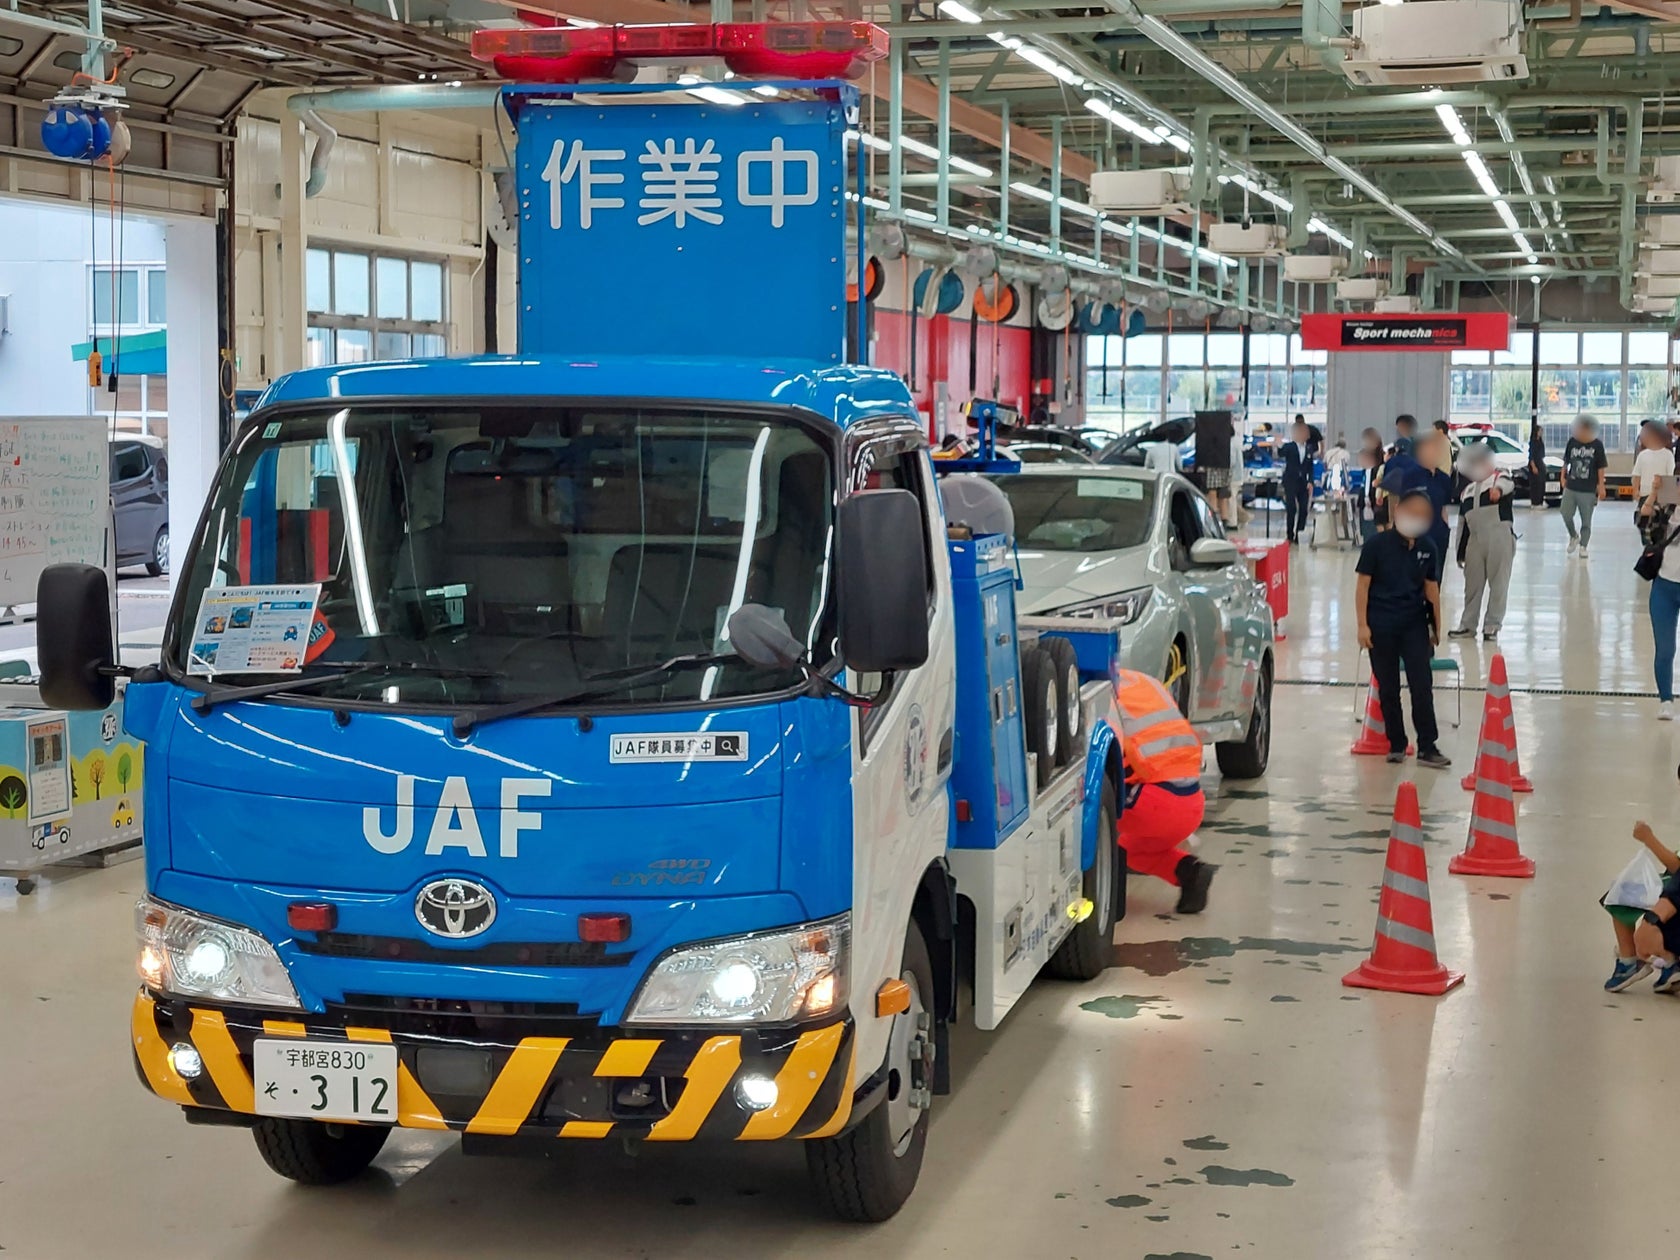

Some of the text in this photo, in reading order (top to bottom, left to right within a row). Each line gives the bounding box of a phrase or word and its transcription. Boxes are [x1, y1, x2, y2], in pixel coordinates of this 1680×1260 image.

[541, 137, 819, 229] 作業中
[1353, 327, 1389, 340] Sport
[309, 622, 327, 643] JAF
[363, 774, 552, 858] JAF
